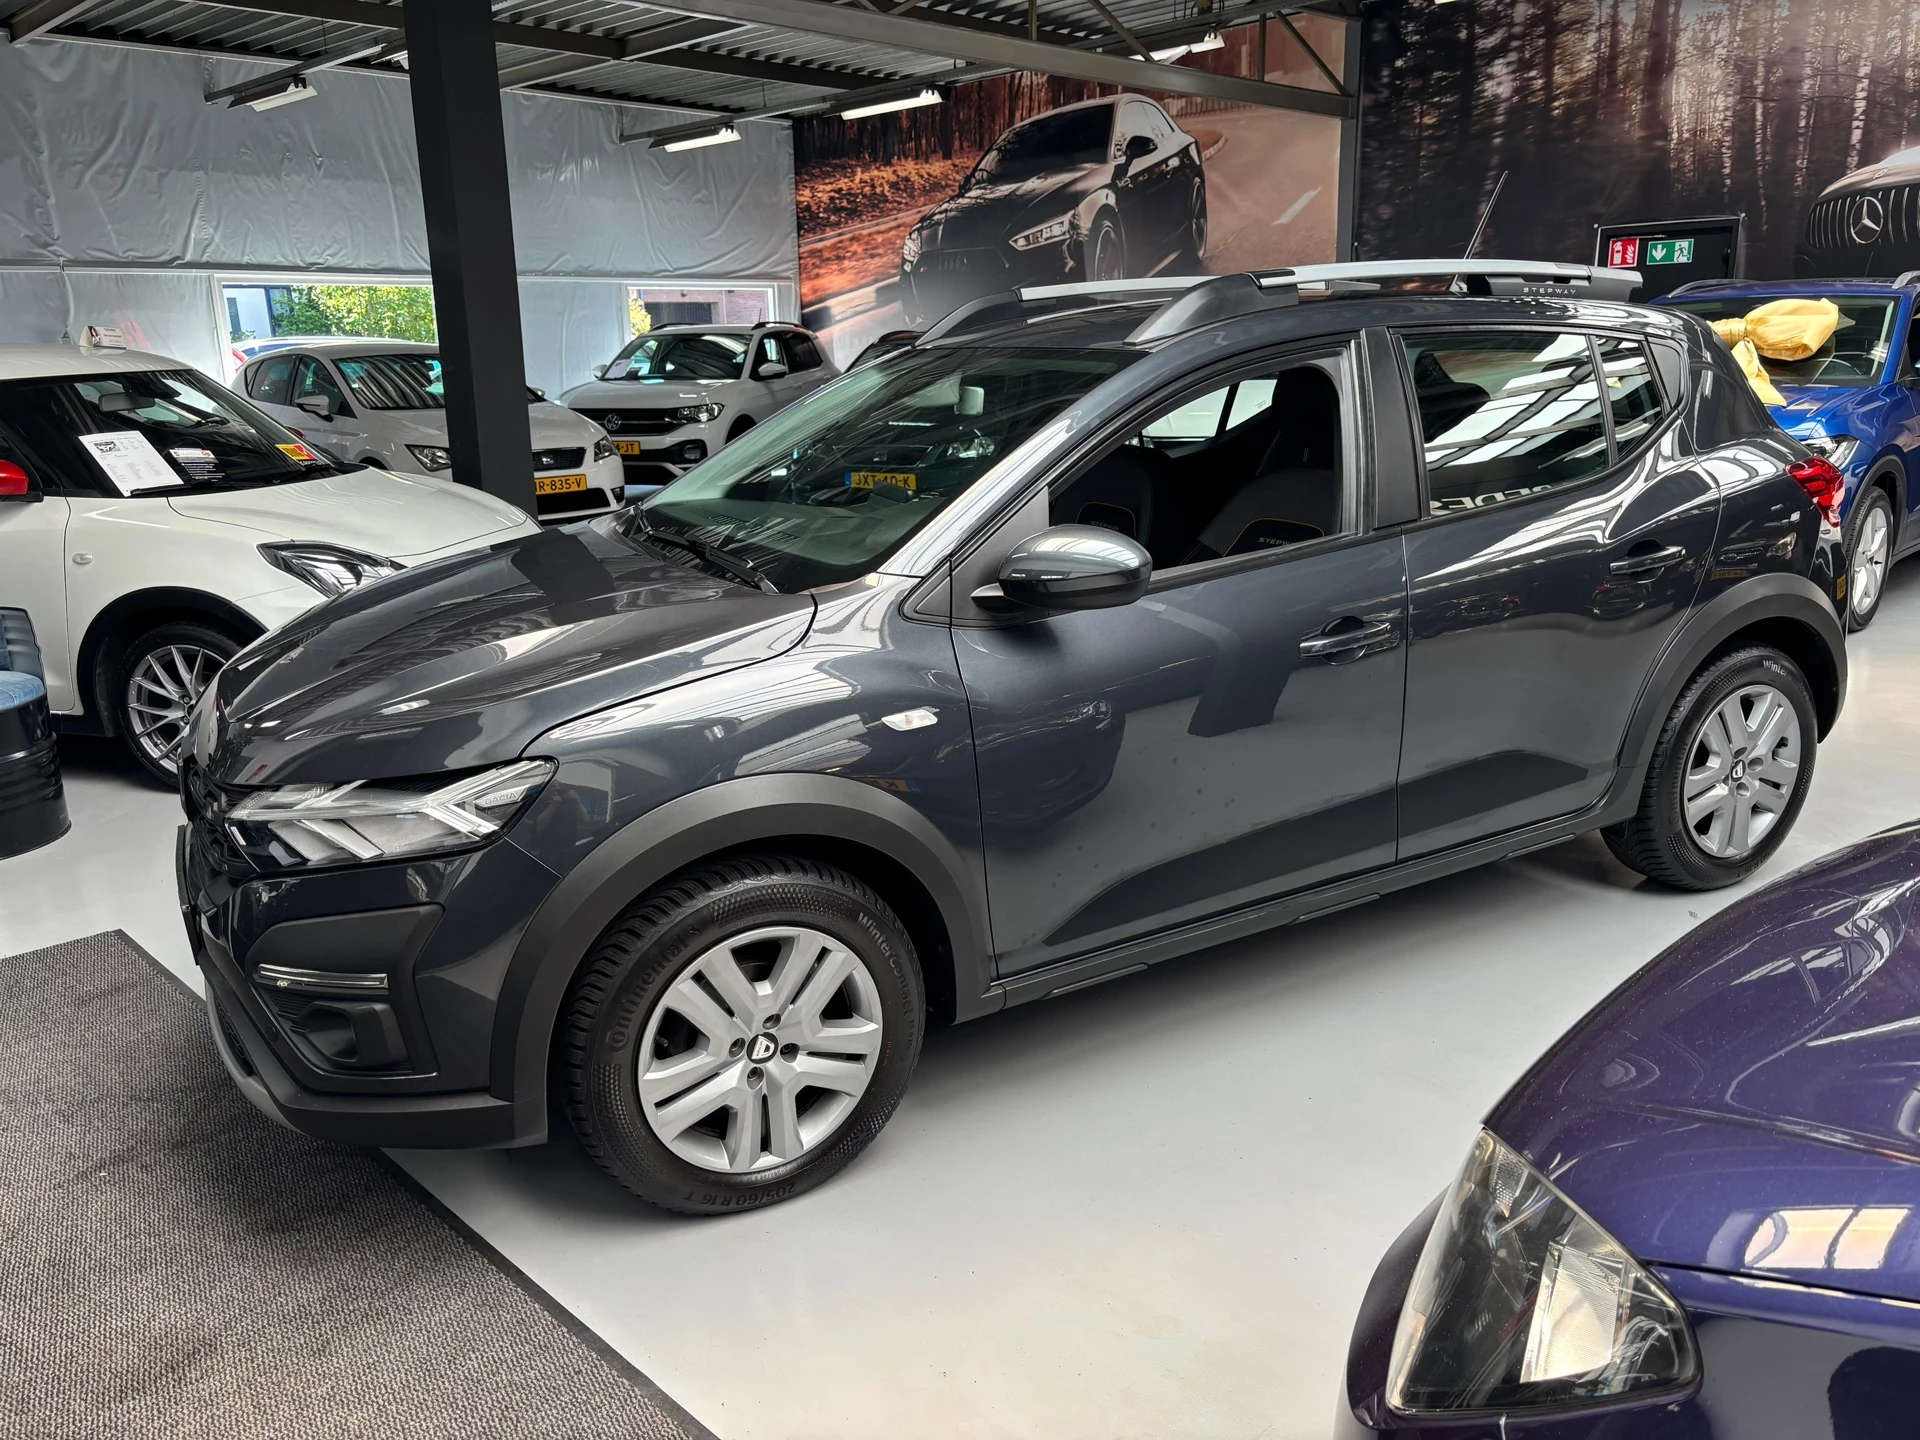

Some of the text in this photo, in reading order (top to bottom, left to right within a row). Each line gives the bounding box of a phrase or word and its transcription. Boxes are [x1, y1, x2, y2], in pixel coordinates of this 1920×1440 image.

[1523, 287, 1576, 295] STEPWAY
[535, 478, 582, 492] R-835-V
[1258, 536, 1293, 546] STEPW
[485, 792, 517, 804] DACIA
[736, 1182, 796, 1206] 205/60
